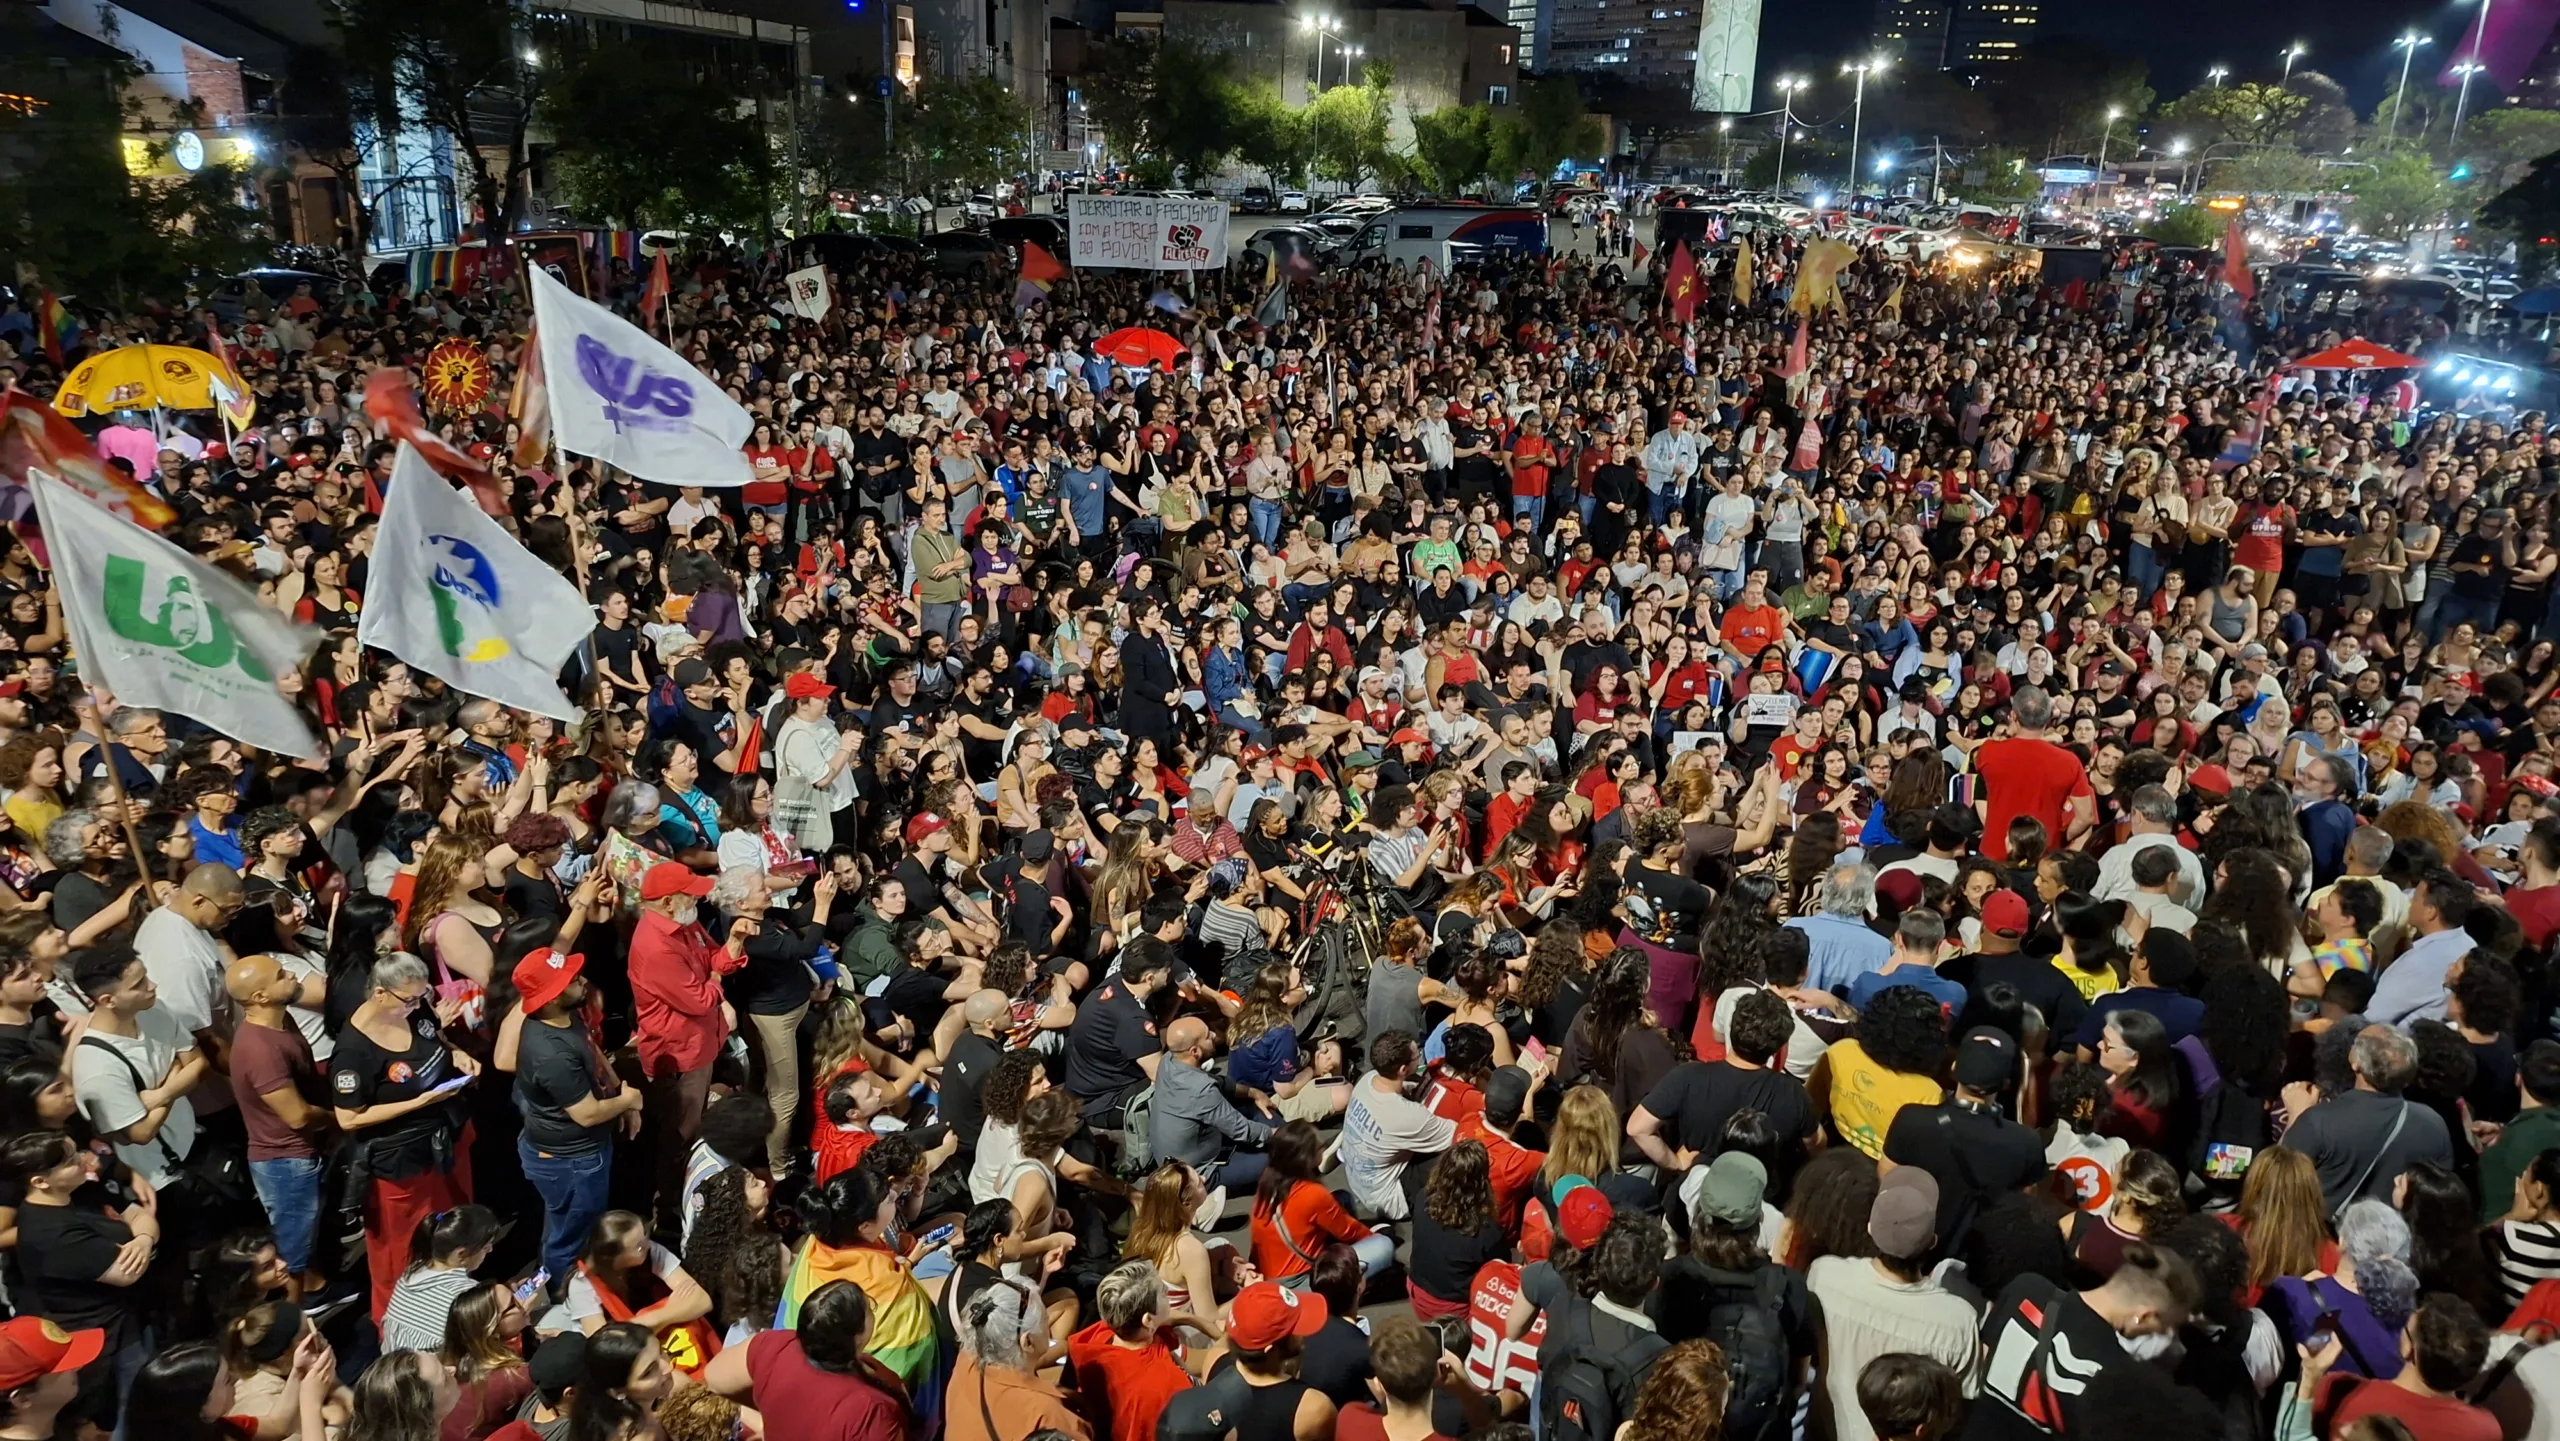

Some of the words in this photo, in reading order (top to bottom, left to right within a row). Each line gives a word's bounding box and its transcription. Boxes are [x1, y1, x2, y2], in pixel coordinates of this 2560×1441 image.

[1078, 199, 1142, 217] DERROTAR
[1156, 202, 1219, 223] FASCISMO
[1079, 222, 1100, 236] COM
[1102, 224, 1110, 237] A
[1114, 221, 1158, 241] FORÇA
[1079, 240, 1093, 255] DO
[1101, 240, 1149, 262] POVO!
[1164, 246, 1207, 262] ALICERCE
[338, 1073, 355, 1082] FCK
[1465, 1317, 1539, 1400] 26
